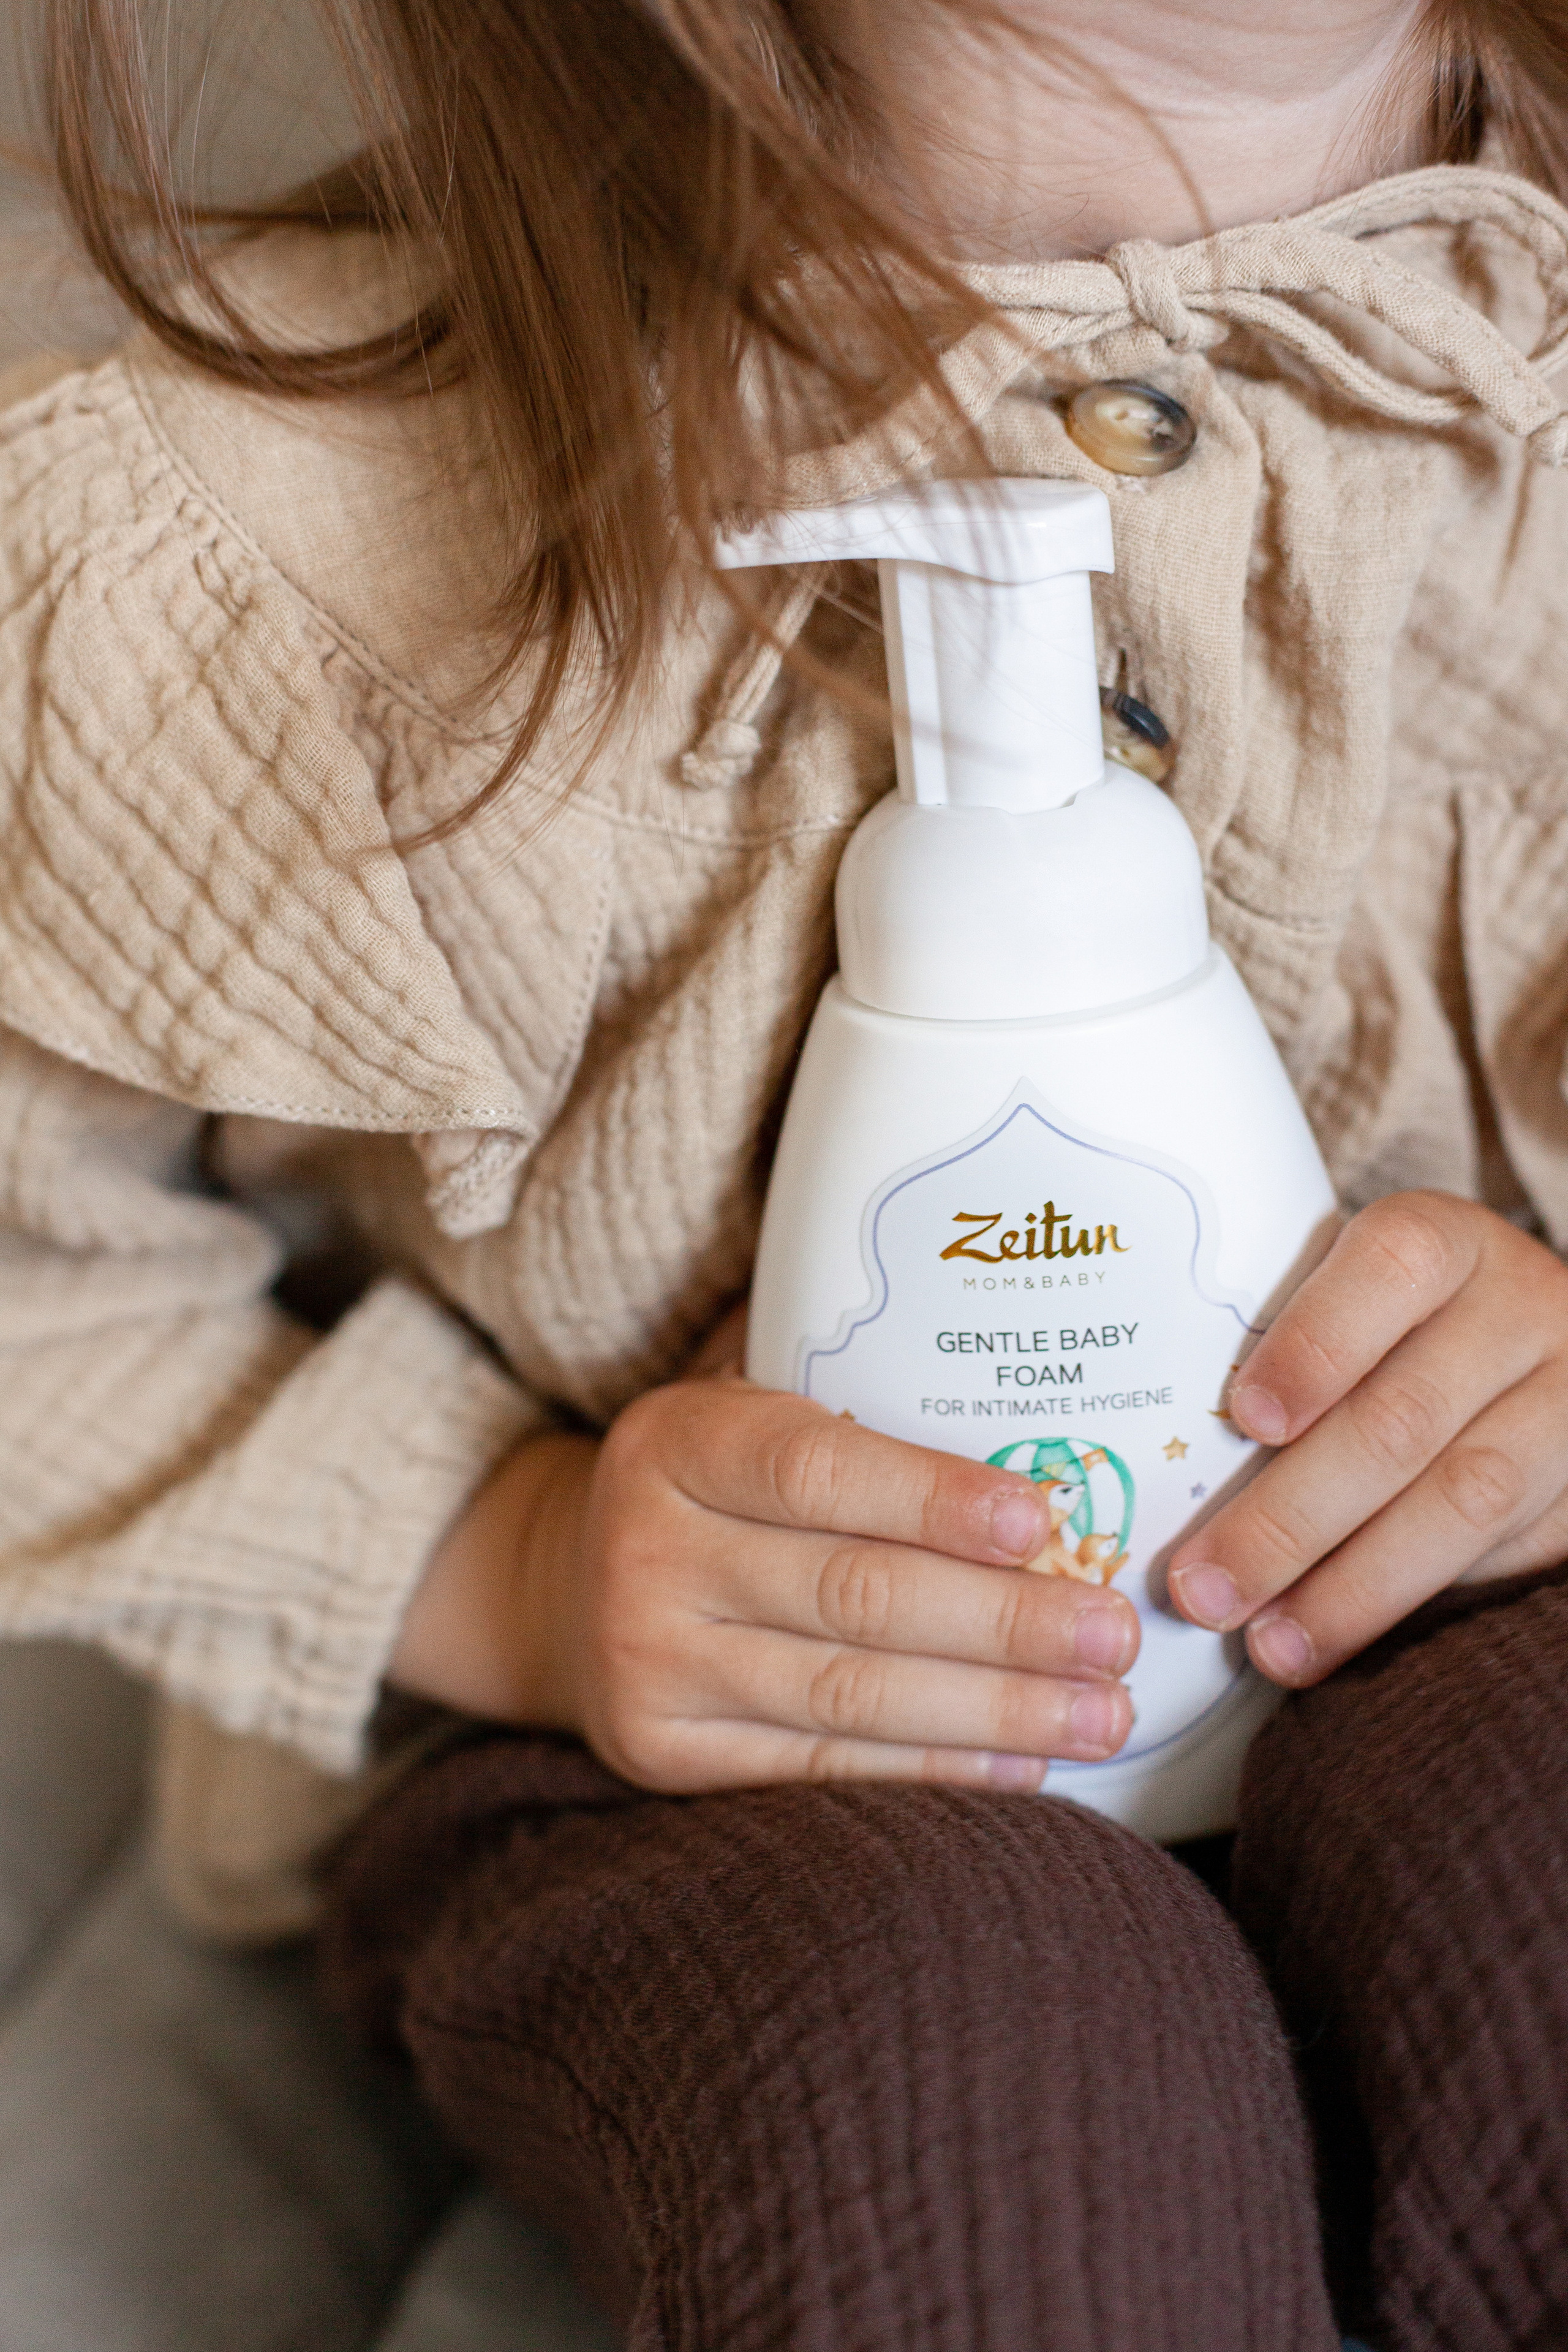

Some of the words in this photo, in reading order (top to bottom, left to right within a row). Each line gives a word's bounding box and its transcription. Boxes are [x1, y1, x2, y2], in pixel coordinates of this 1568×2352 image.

[940, 1200, 1133, 1264] Zeitun
[963, 1271, 1106, 1291] MOM&BABY
[936, 1331, 1050, 1354] GENTLE
[1060, 1322, 1139, 1351] BABY
[996, 1363, 1084, 1387] FOAM
[921, 1398, 965, 1416] FOR
[972, 1397, 1073, 1417] INTIMATE
[1081, 1387, 1174, 1412] HYGIENE
